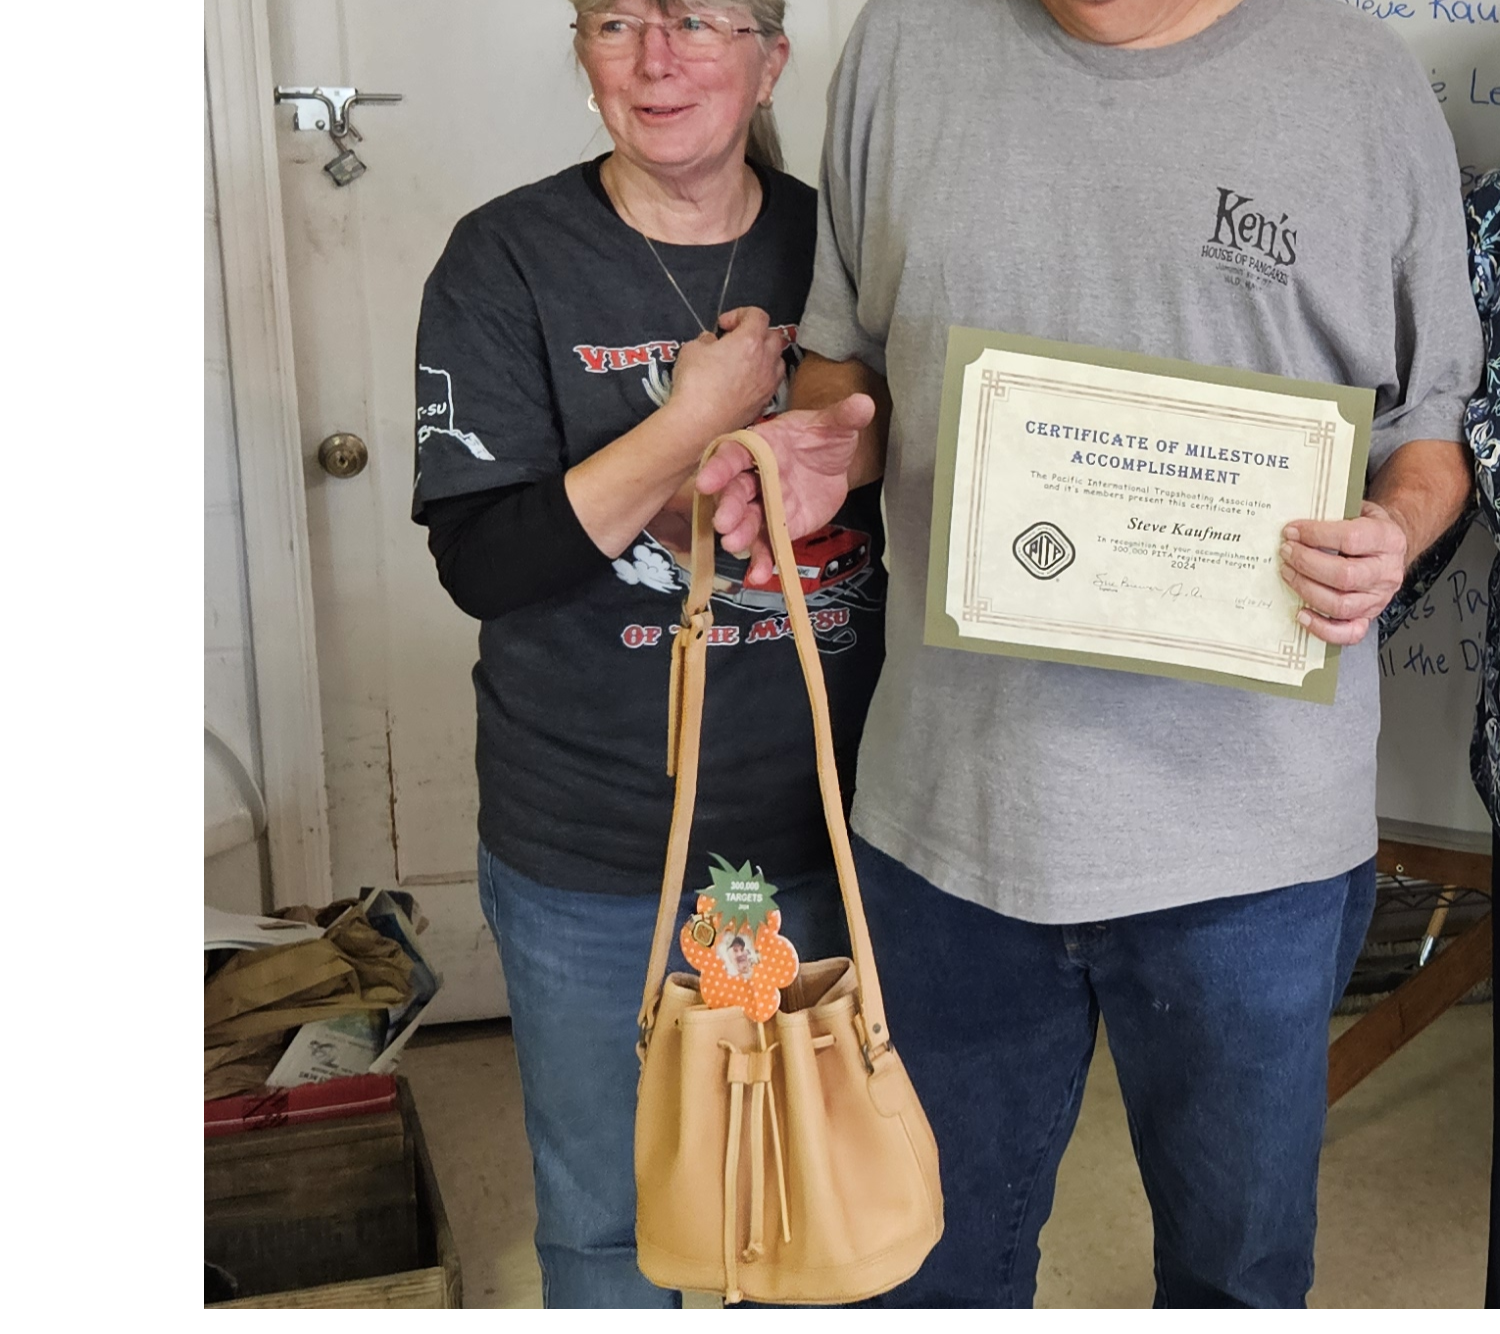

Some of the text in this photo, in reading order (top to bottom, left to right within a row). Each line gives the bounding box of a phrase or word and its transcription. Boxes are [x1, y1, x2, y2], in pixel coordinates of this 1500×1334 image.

[1207, 186, 1298, 267] Ken's
[1201, 245, 1233, 263] HOUSE
[1235, 253, 1248, 266] OF
[1025, 420, 1291, 470] CERTIFICATE OF MILESTONE
[1070, 450, 1241, 486] ACCOMPLISHMENT
[1031, 471, 1273, 510] The Pacific International Trapshooting Association
[1043, 483, 1060, 492] and
[1083, 487, 1125, 501] members
[1128, 494, 1165, 507] present
[1168, 499, 1187, 509] this
[1190, 501, 1243, 516] certificate
[1246, 508, 1256, 517] to
[1127, 517, 1243, 543] Steve Kaufman
[1097, 535, 1273, 565] In recognition of your accomplishment of
[1112, 545, 1256, 571] 300,000 PITA registered targets
[1170, 560, 1197, 571] 2024
[620, 623, 662, 649] OF
[1403, 642, 1450, 676] the
[724, 892, 764, 903] TARGETS
